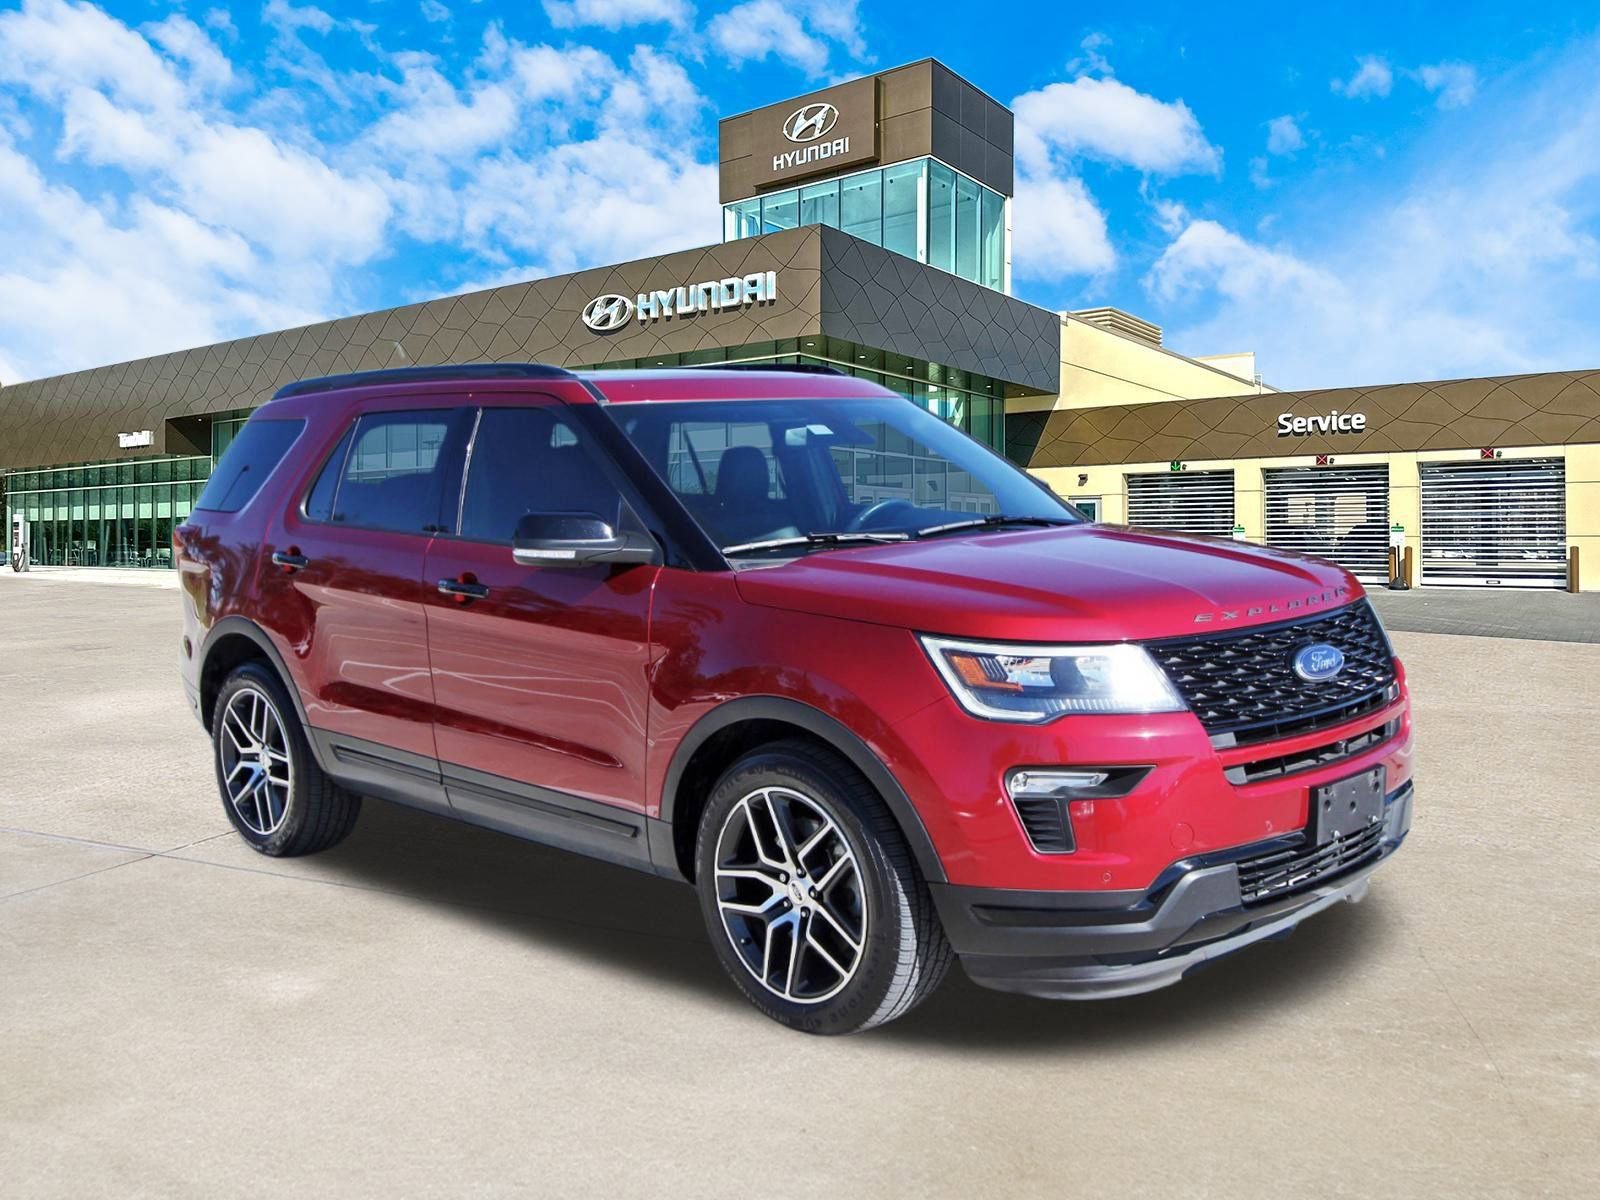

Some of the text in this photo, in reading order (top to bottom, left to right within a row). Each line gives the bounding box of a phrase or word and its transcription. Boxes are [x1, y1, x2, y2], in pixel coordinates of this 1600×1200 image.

[773, 136, 850, 171] HYUNDAI
[637, 270, 777, 321] HYUNDAI
[1277, 410, 1367, 434] Service
[1193, 586, 1346, 624] EXPLORER
[1311, 650, 1336, 672] Ford
